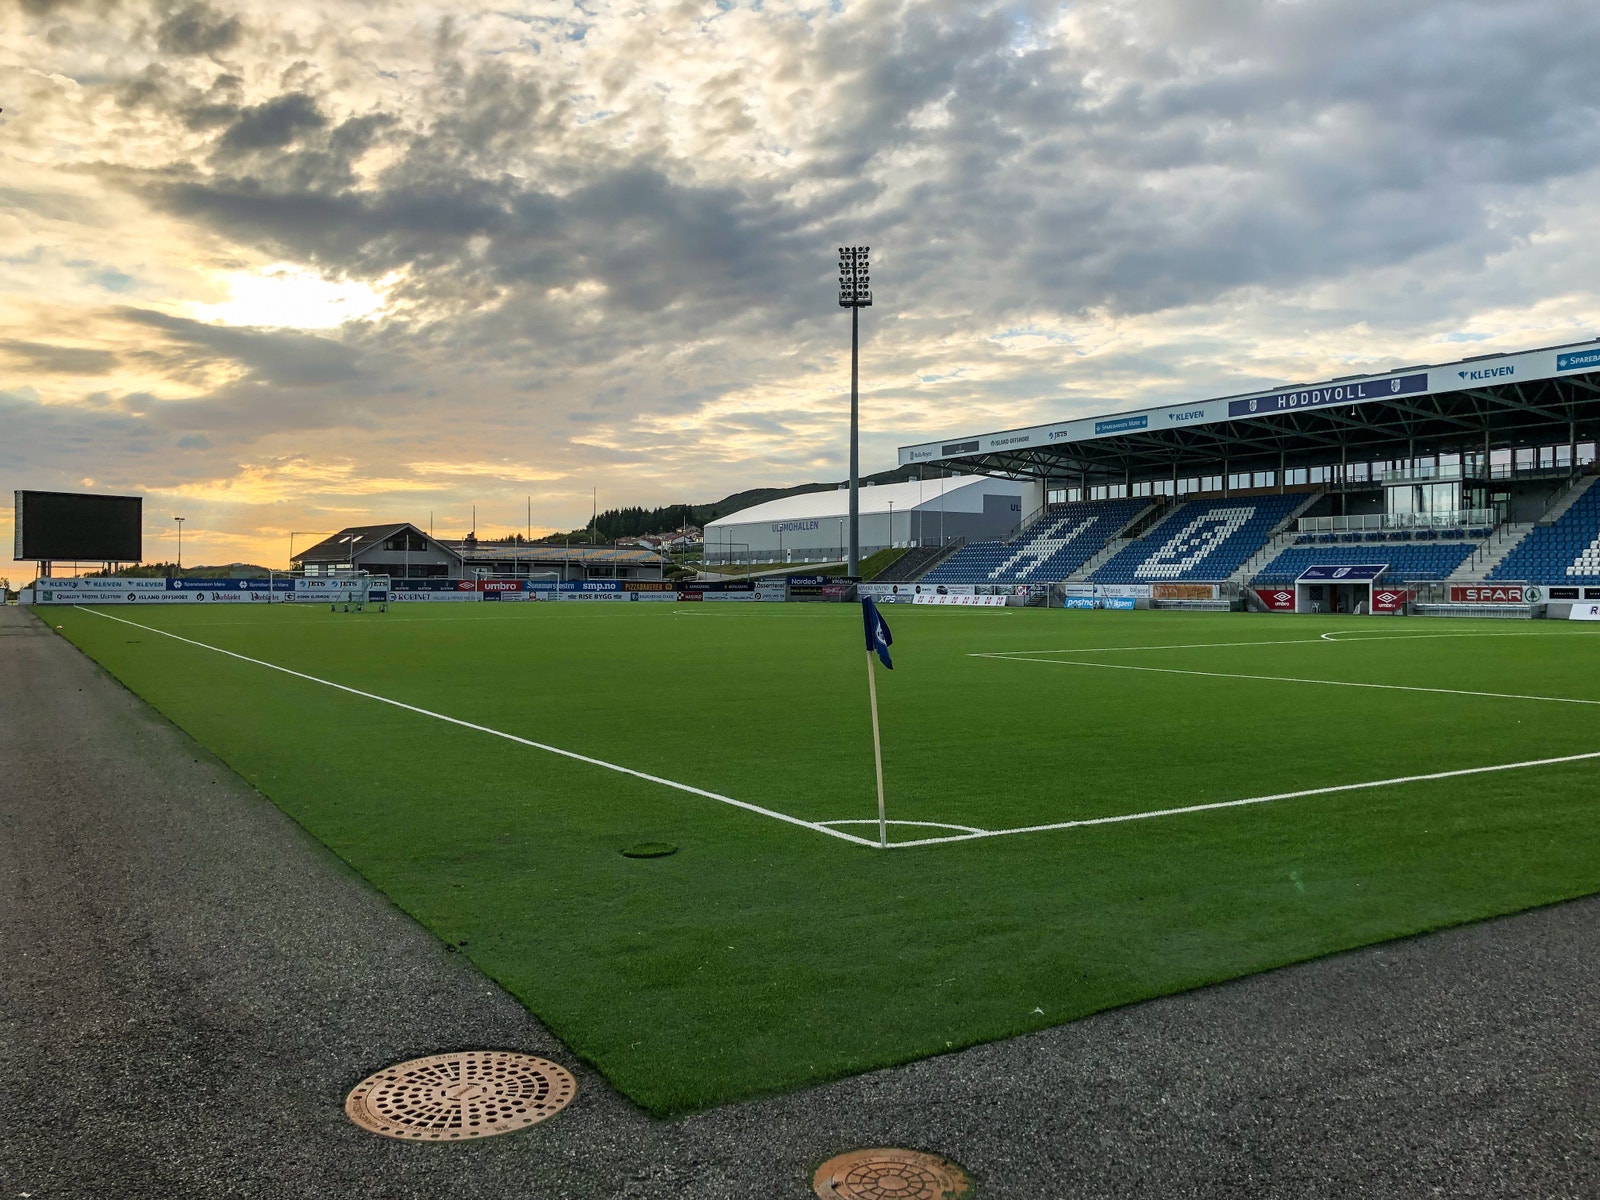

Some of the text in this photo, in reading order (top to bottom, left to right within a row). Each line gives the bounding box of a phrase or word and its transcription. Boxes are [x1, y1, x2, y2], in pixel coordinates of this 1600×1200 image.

[1470, 366, 1514, 380] KLEVEN
[1278, 384, 1366, 408] HØDDVOLL
[1176, 410, 1204, 421] KLEVEN
[1054, 430, 1068, 440] JETS
[1010, 503, 1021, 512] UL
[307, 581, 326, 589] JETS
[339, 581, 358, 589] JETS
[484, 582, 517, 590] umbro
[582, 582, 617, 592] smp.no
[879, 595, 897, 603] XPS
[1466, 589, 1522, 600] SPAR
